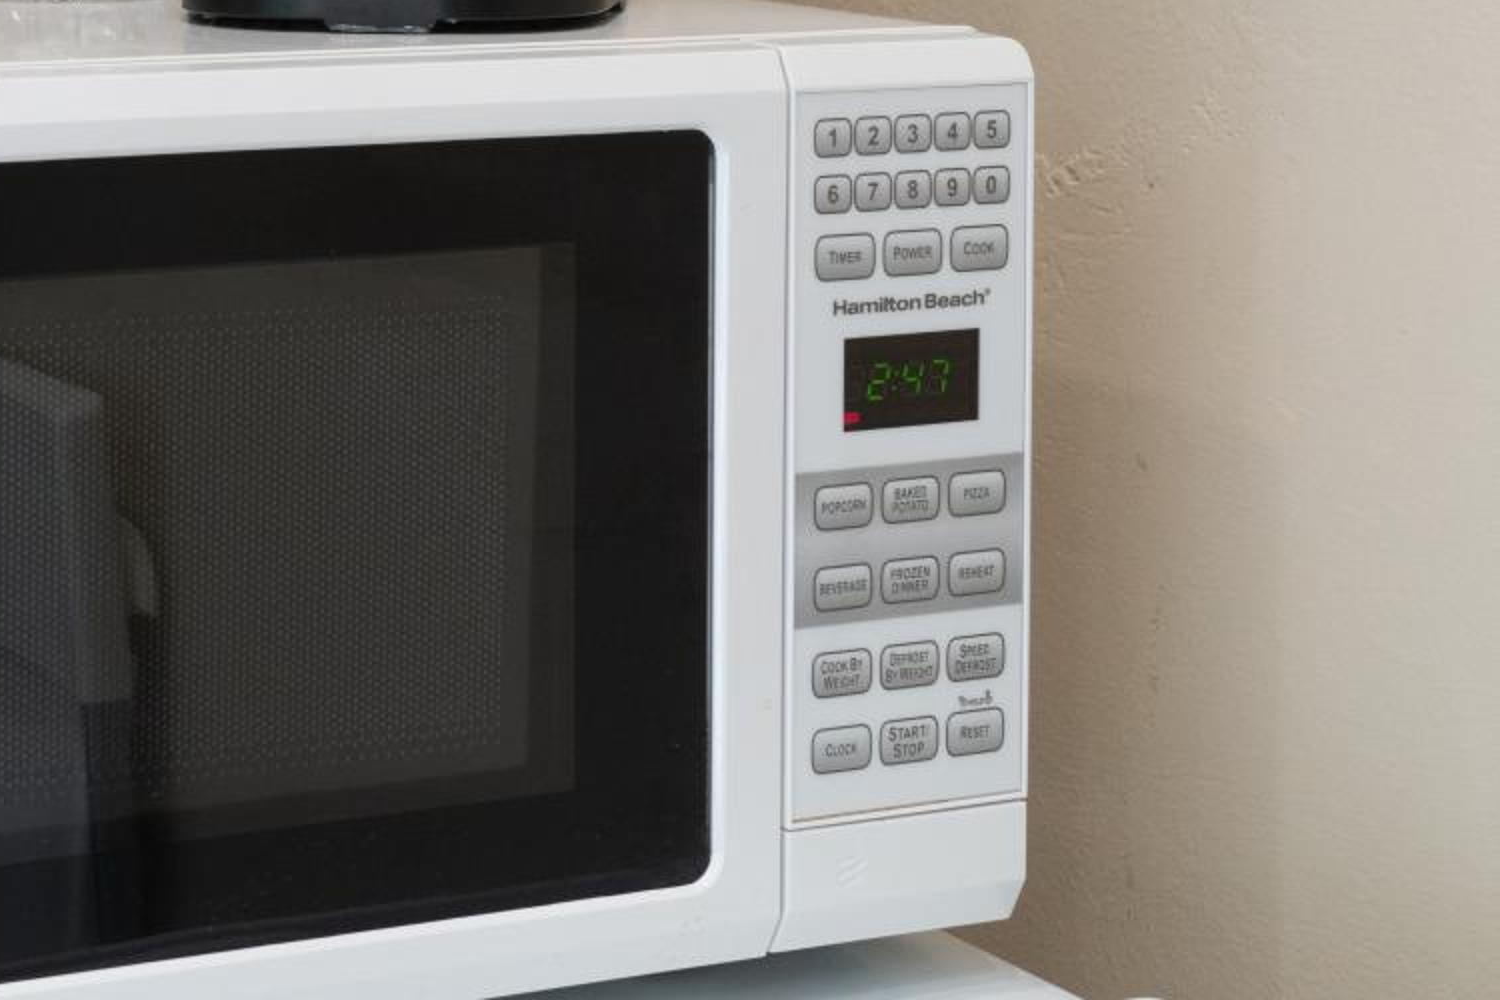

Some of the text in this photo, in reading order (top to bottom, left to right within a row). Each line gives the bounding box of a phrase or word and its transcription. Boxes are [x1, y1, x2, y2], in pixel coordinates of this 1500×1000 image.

[829, 128, 837, 147] 1
[868, 126, 879, 146] 2
[908, 124, 918, 143] 3
[947, 122, 958, 141] 4
[987, 120, 997, 139] 5
[868, 182, 878, 201] 7
[908, 180, 918, 199] 8
[947, 178, 957, 197] 9
[986, 175, 996, 194] 0
[828, 185, 838, 204] 6
[893, 245, 932, 260] POWER
[833, 296, 921, 316] Hamilton
[867, 359, 949, 401] 2:47
[963, 487, 990, 499] PIZZA
[888, 726, 925, 741] START
[894, 742, 925, 758] STOP
